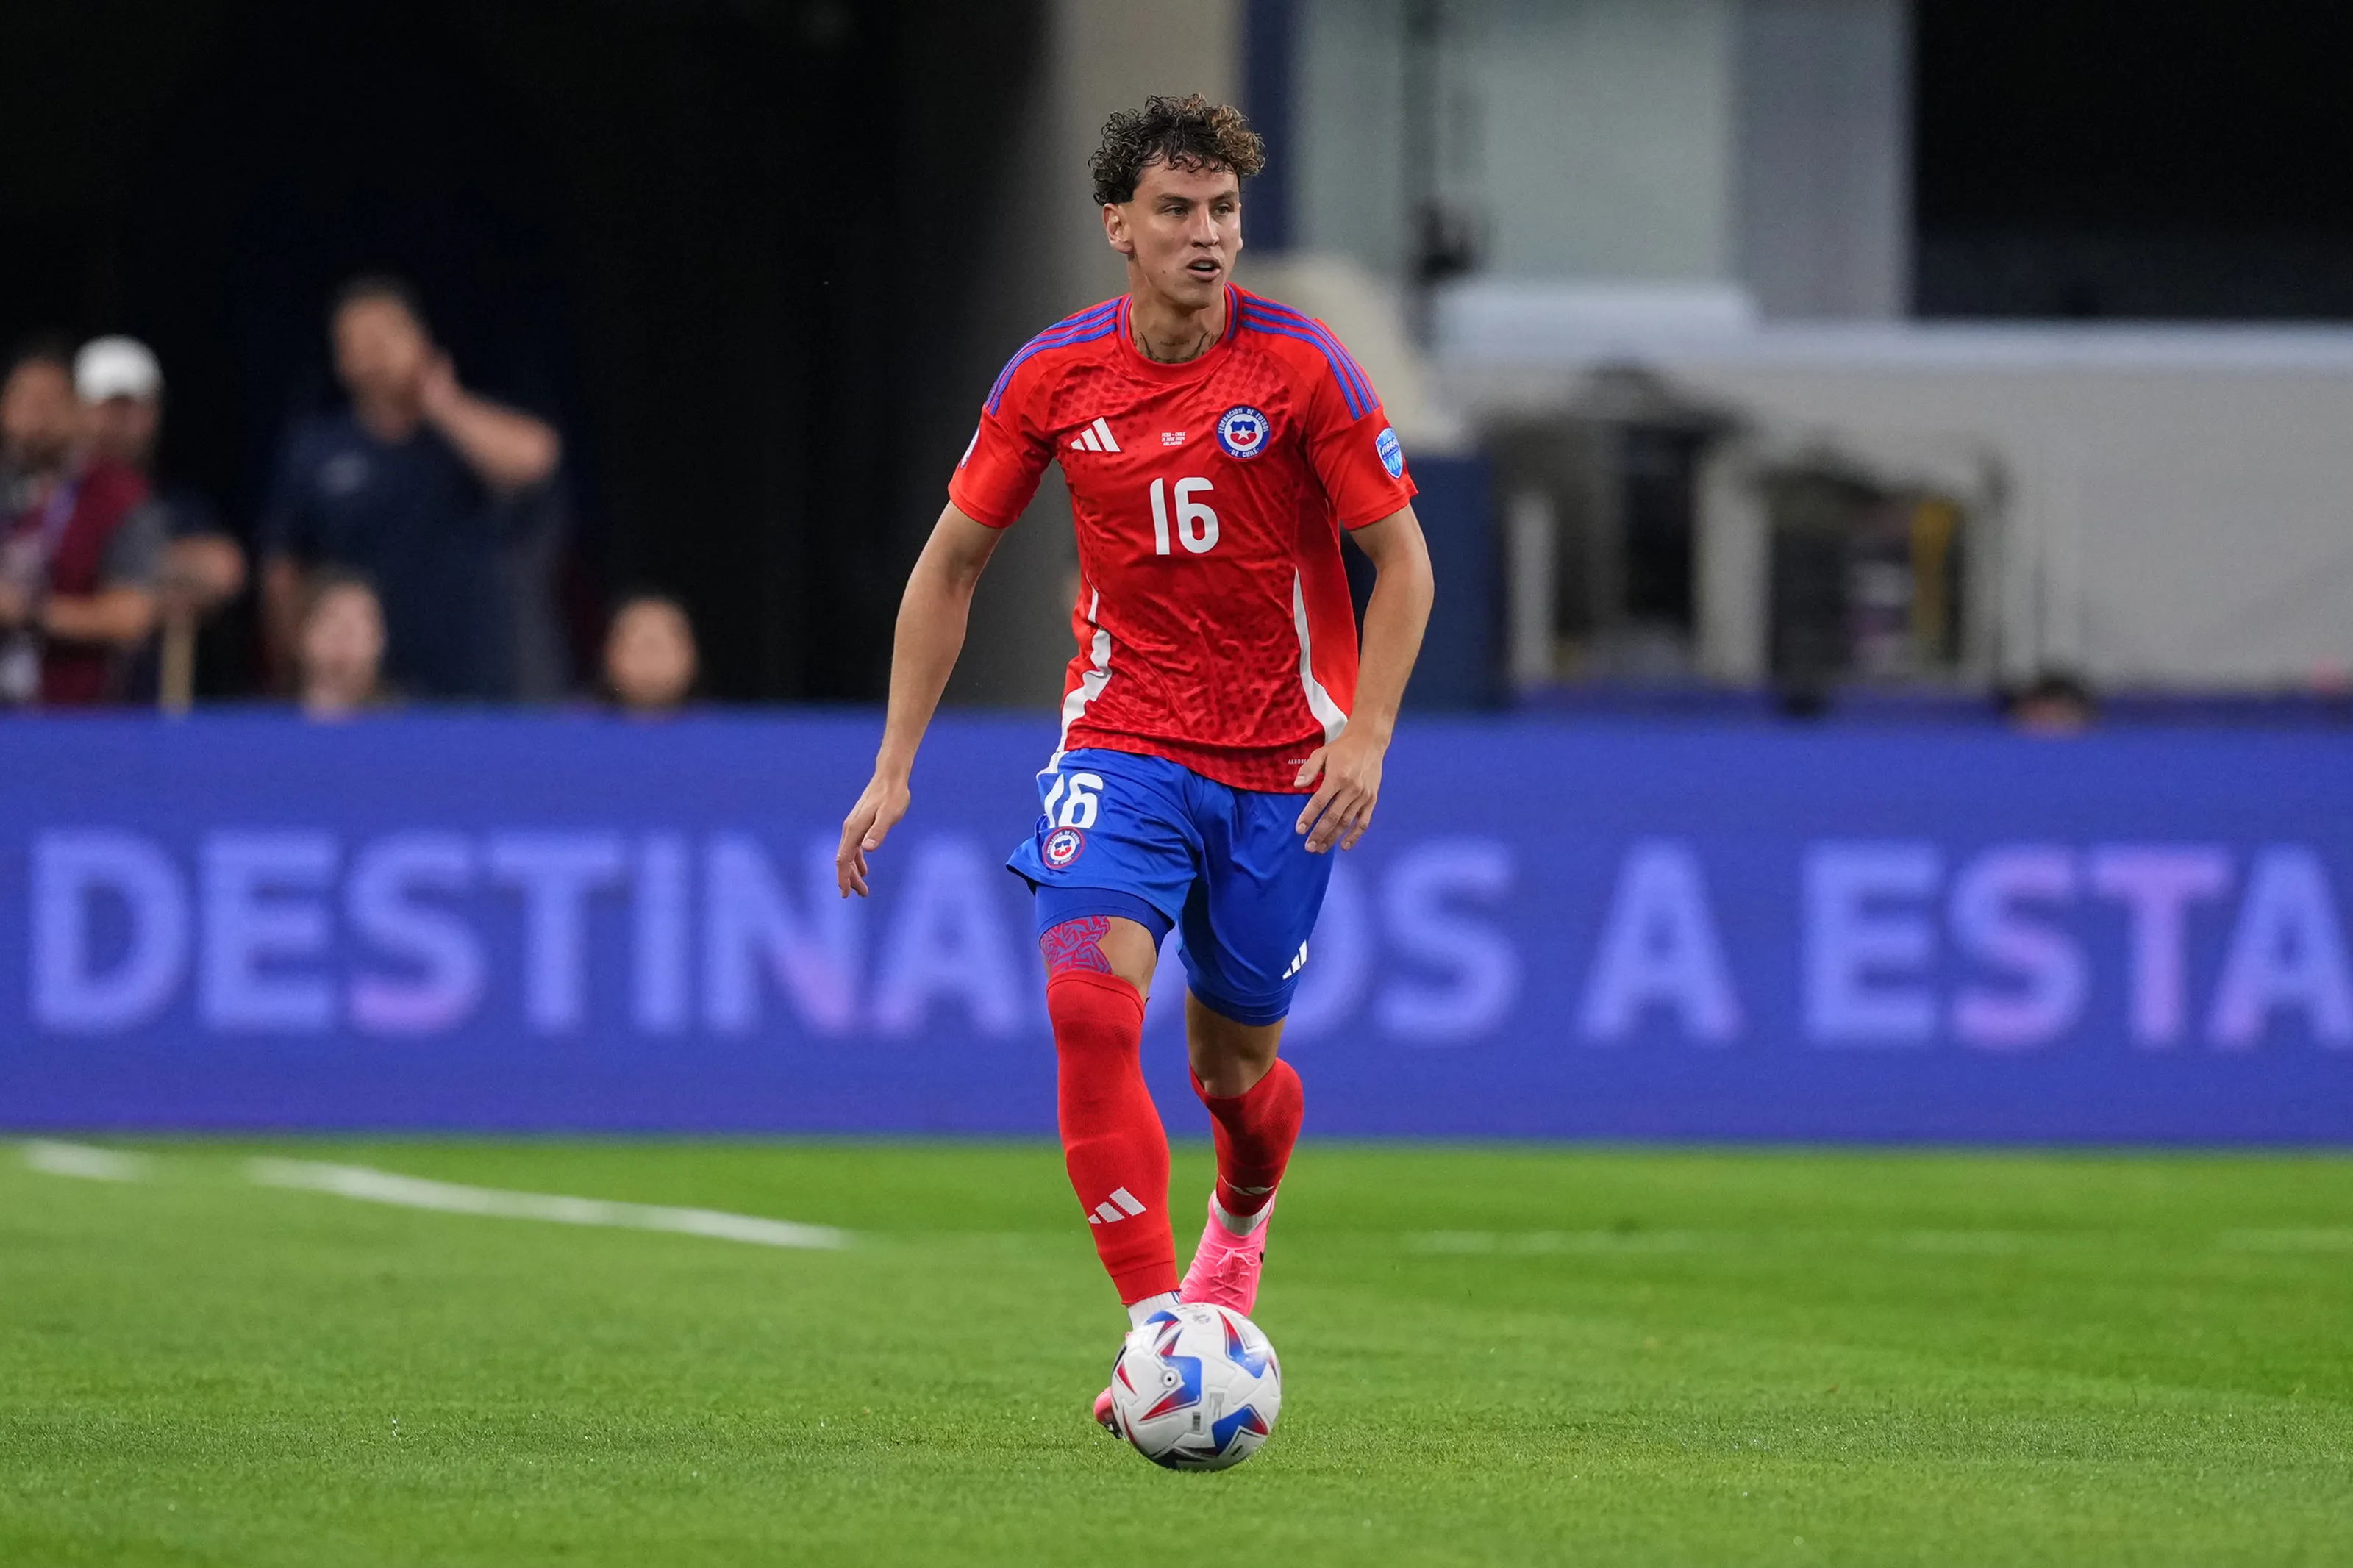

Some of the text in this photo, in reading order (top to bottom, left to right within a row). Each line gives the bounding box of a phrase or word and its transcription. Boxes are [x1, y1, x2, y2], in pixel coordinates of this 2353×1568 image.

[1255, 412, 1270, 432] FUTBOL
[1242, 448, 1259, 457] CHILE
[1149, 476, 1219, 555] 16
[1044, 773, 1104, 829] 16
[26, 828, 2353, 1048] DESTINAS A ESTA
